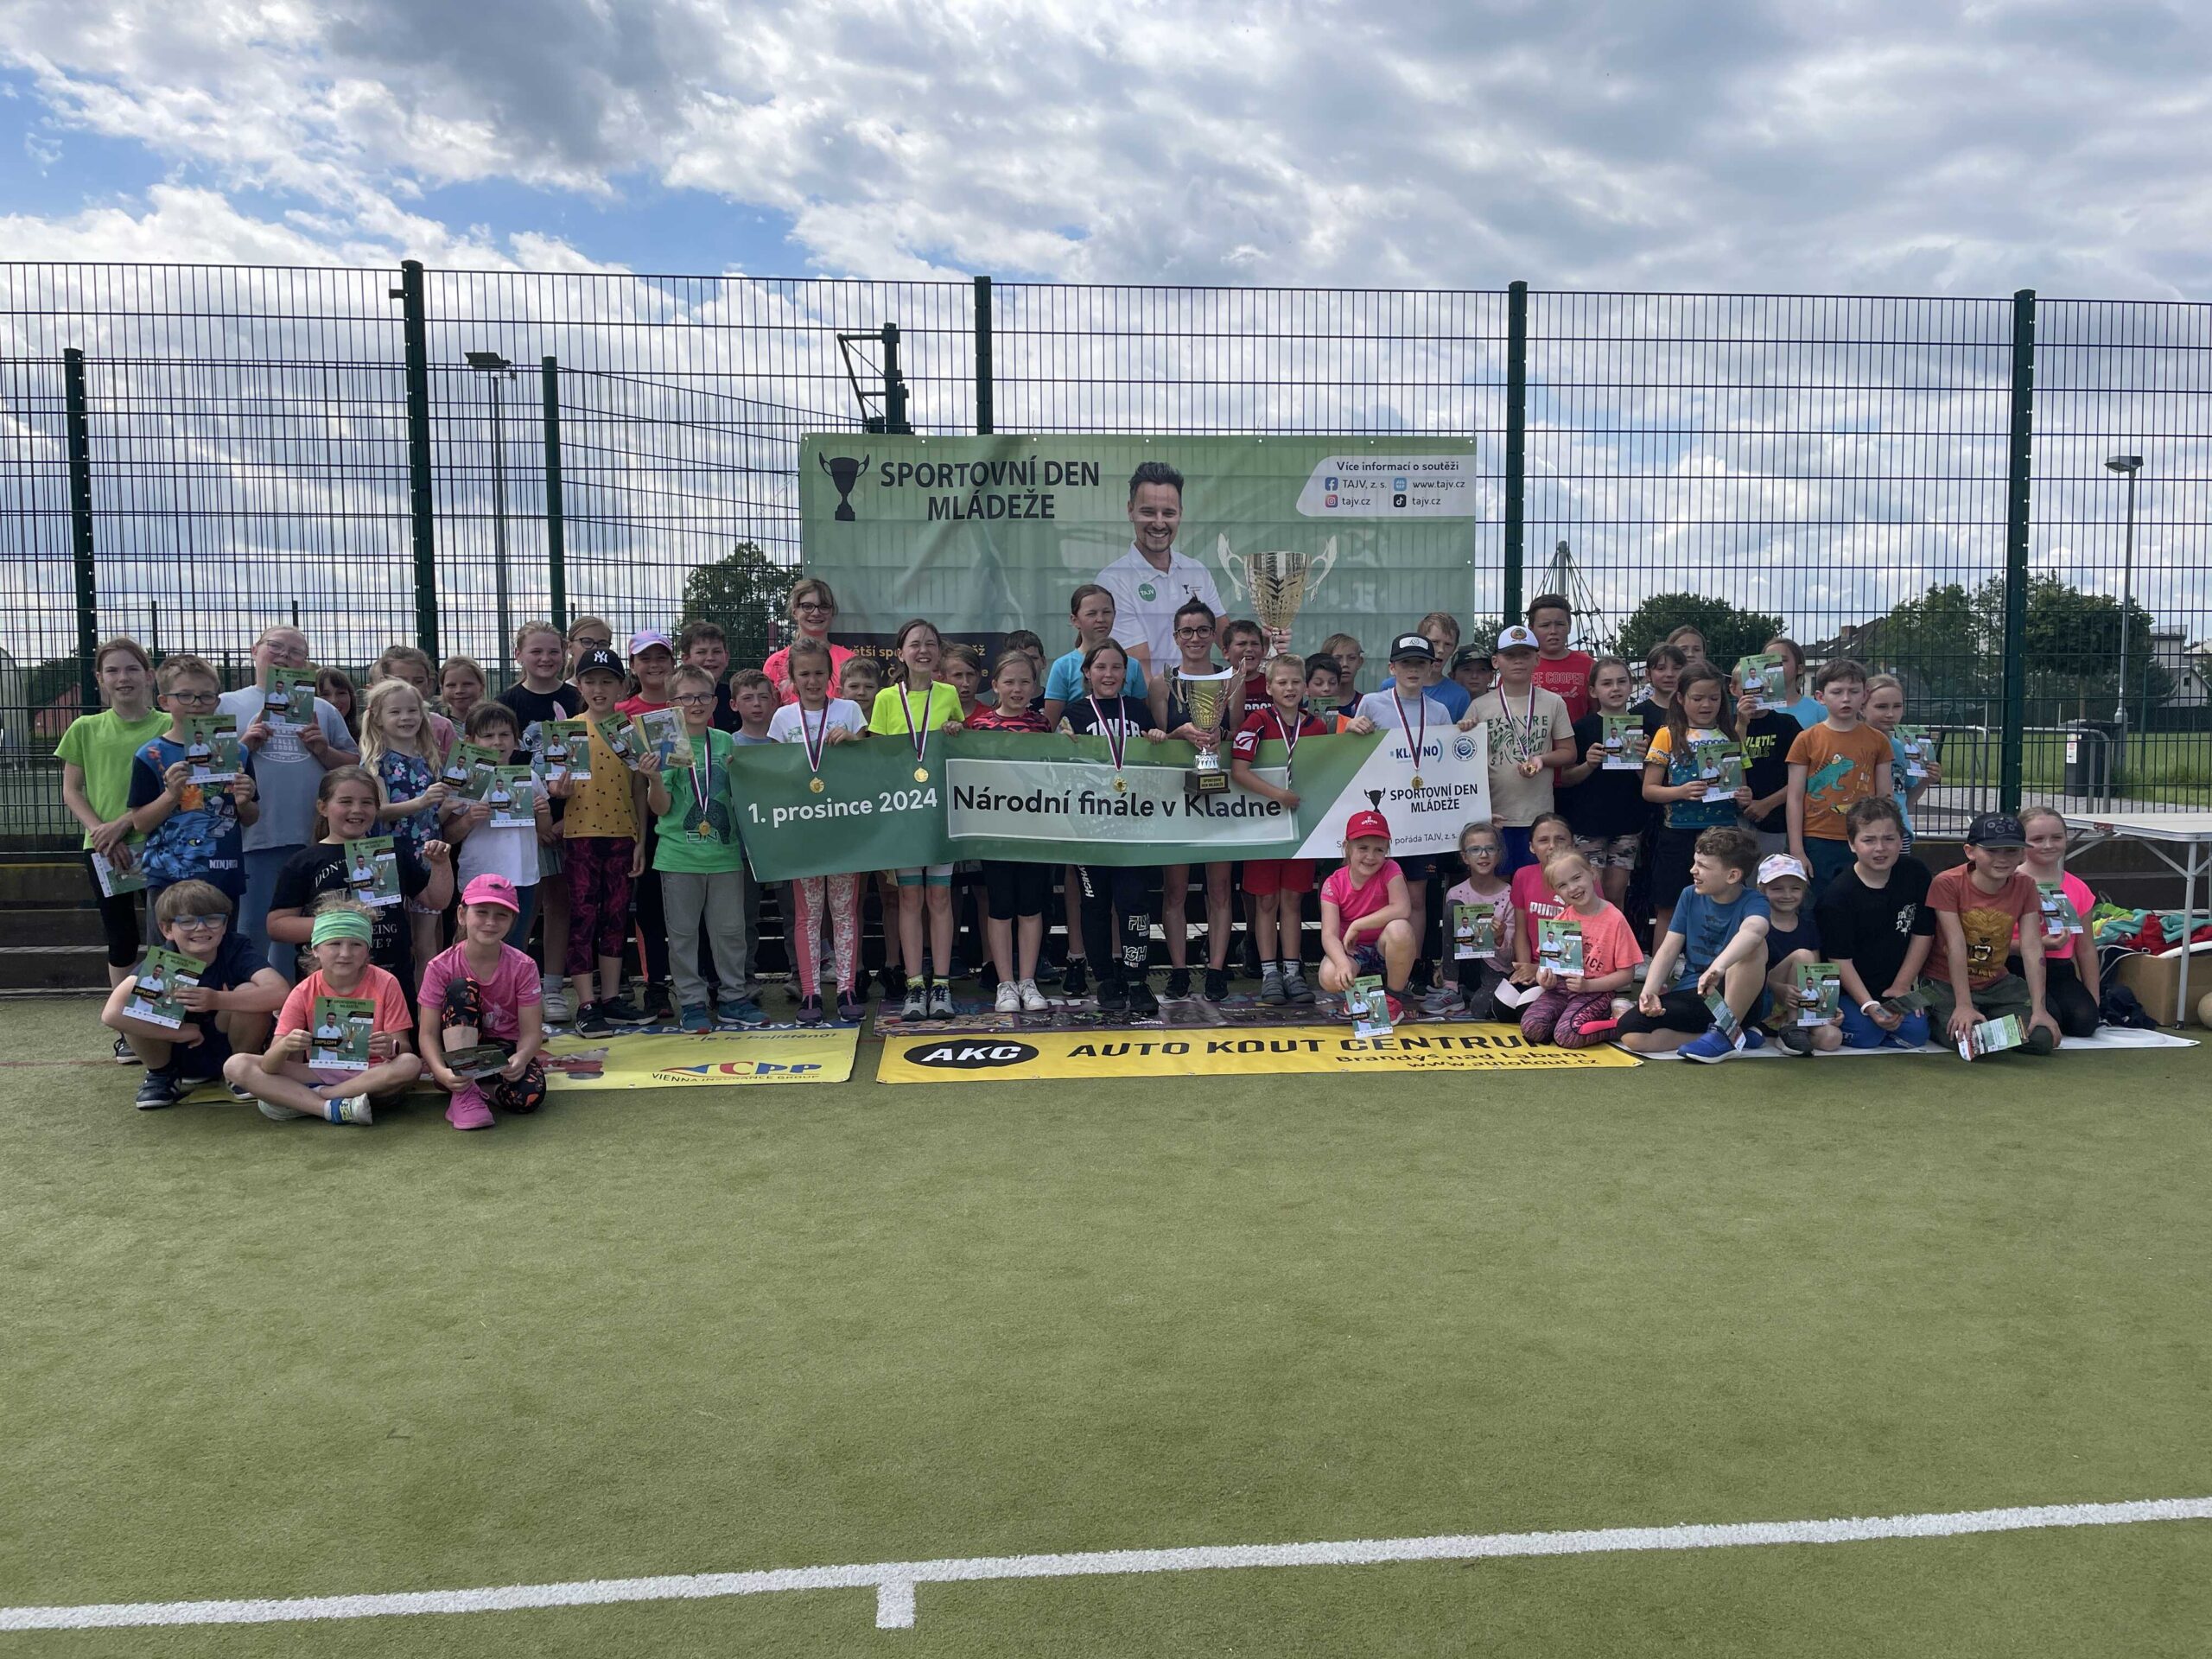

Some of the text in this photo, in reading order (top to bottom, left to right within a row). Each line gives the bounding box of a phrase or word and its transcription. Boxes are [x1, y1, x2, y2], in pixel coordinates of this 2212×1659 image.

[880, 455, 1099, 487] SPORTOVNÍ DEN
[1337, 461, 1359, 471] Více
[1362, 461, 1411, 471] informací
[1422, 461, 1459, 471] soutěži
[1343, 480, 1368, 490] TAJV,
[1413, 480, 1466, 491] www.tajv.cz
[927, 488, 1056, 521] MLÁDEŽE
[1342, 498, 1371, 508] tajv.cz
[1412, 497, 1441, 508] tajv.cz
[594, 651, 608, 664] NY
[850, 645, 876, 657] ětší
[1390, 783, 1478, 801] SPORTOVNÍ DEN
[747, 787, 938, 828] 1. prosince 2024
[952, 785, 1071, 815] Národní
[1077, 790, 1154, 817] finále
[1161, 801, 1177, 817] v
[1411, 797, 1460, 813] MLÁDEŽE
[1395, 835, 1422, 845] pořádá
[1425, 832, 1444, 842] TAJV,
[372, 923, 398, 935] EING
[921, 1046, 1022, 1062] AKC
[1066, 1041, 1191, 1058] AUTO
[1206, 1039, 1326, 1054] KOUT
[1335, 1051, 1588, 1064] Brandýs nad Labem
[1406, 1057, 1601, 1068] www.autokout.cz
[652, 1072, 698, 1083] VIENNA
